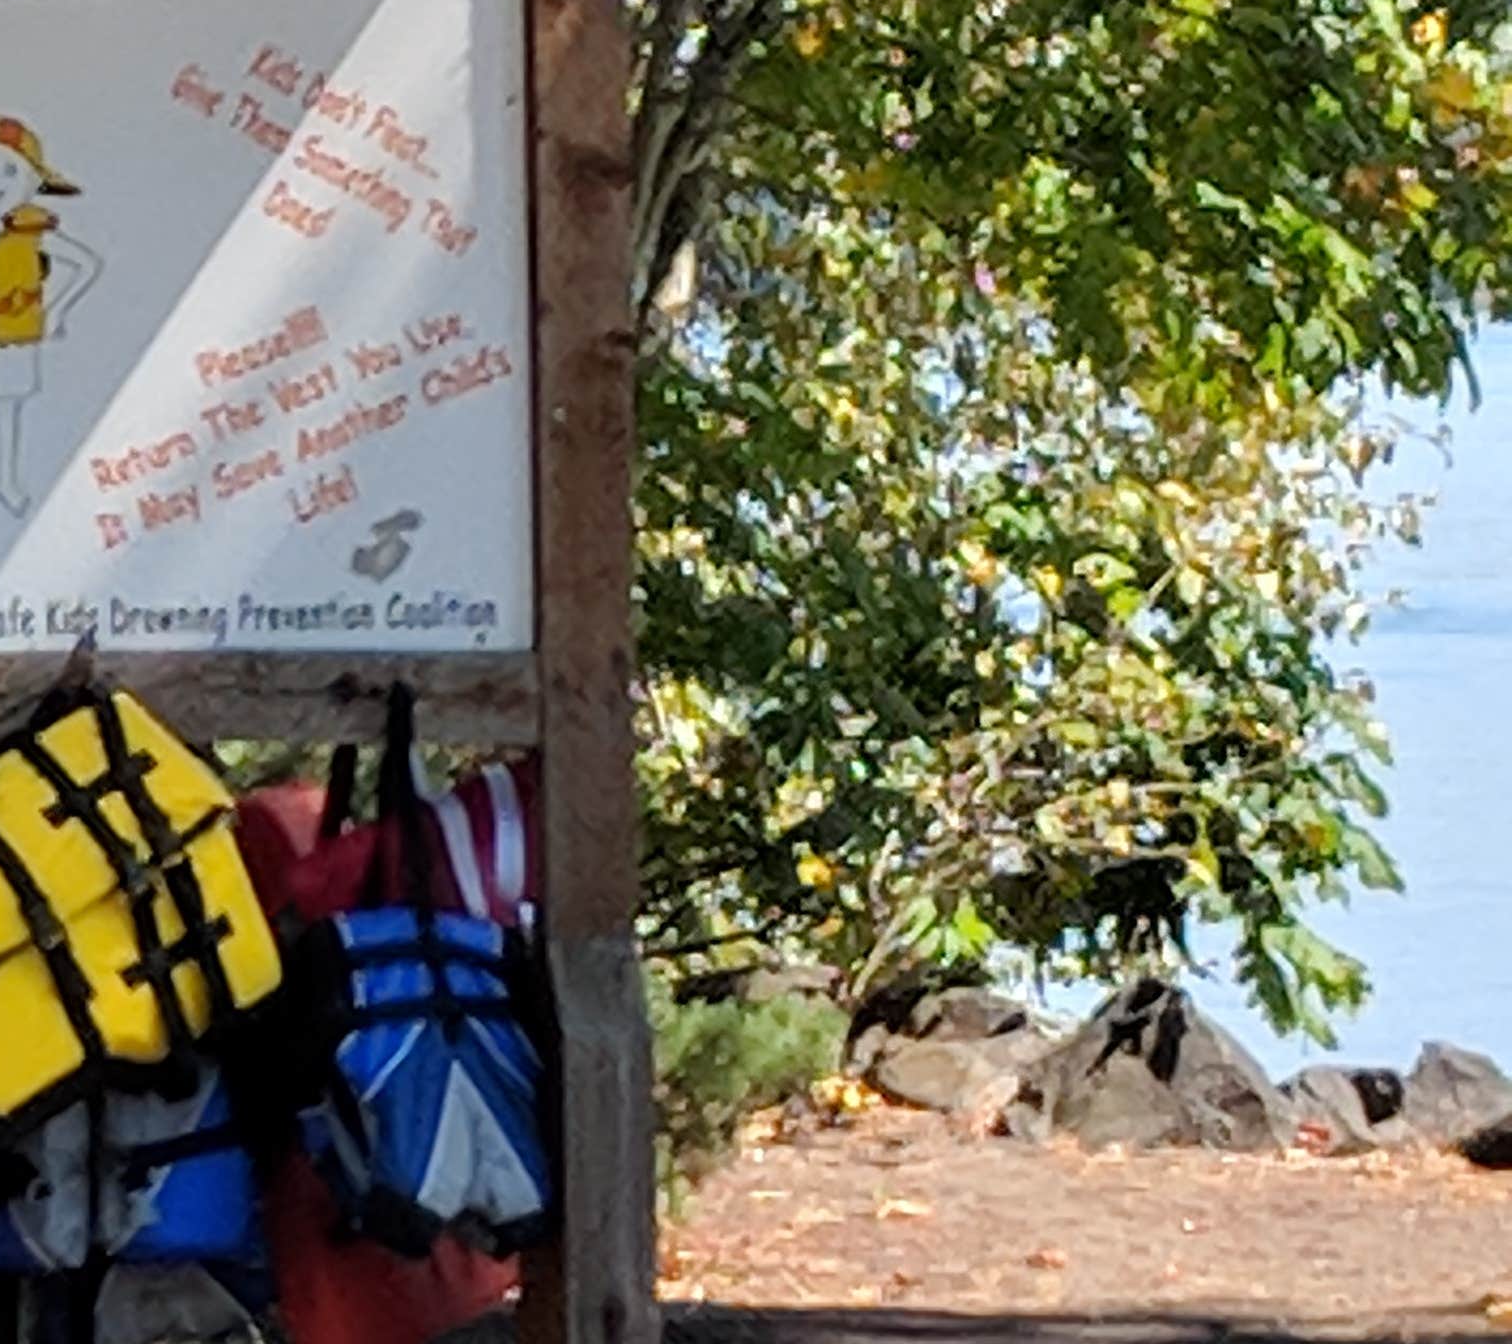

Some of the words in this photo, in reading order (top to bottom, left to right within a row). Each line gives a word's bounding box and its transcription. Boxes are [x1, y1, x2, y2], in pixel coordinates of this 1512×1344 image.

[89, 431, 197, 493] Return
[200, 399, 266, 441] The
[267, 362, 339, 414] Vest
[344, 341, 403, 379] You
[136, 484, 202, 532] May
[211, 448, 285, 501] Save
[296, 393, 409, 464] Another
